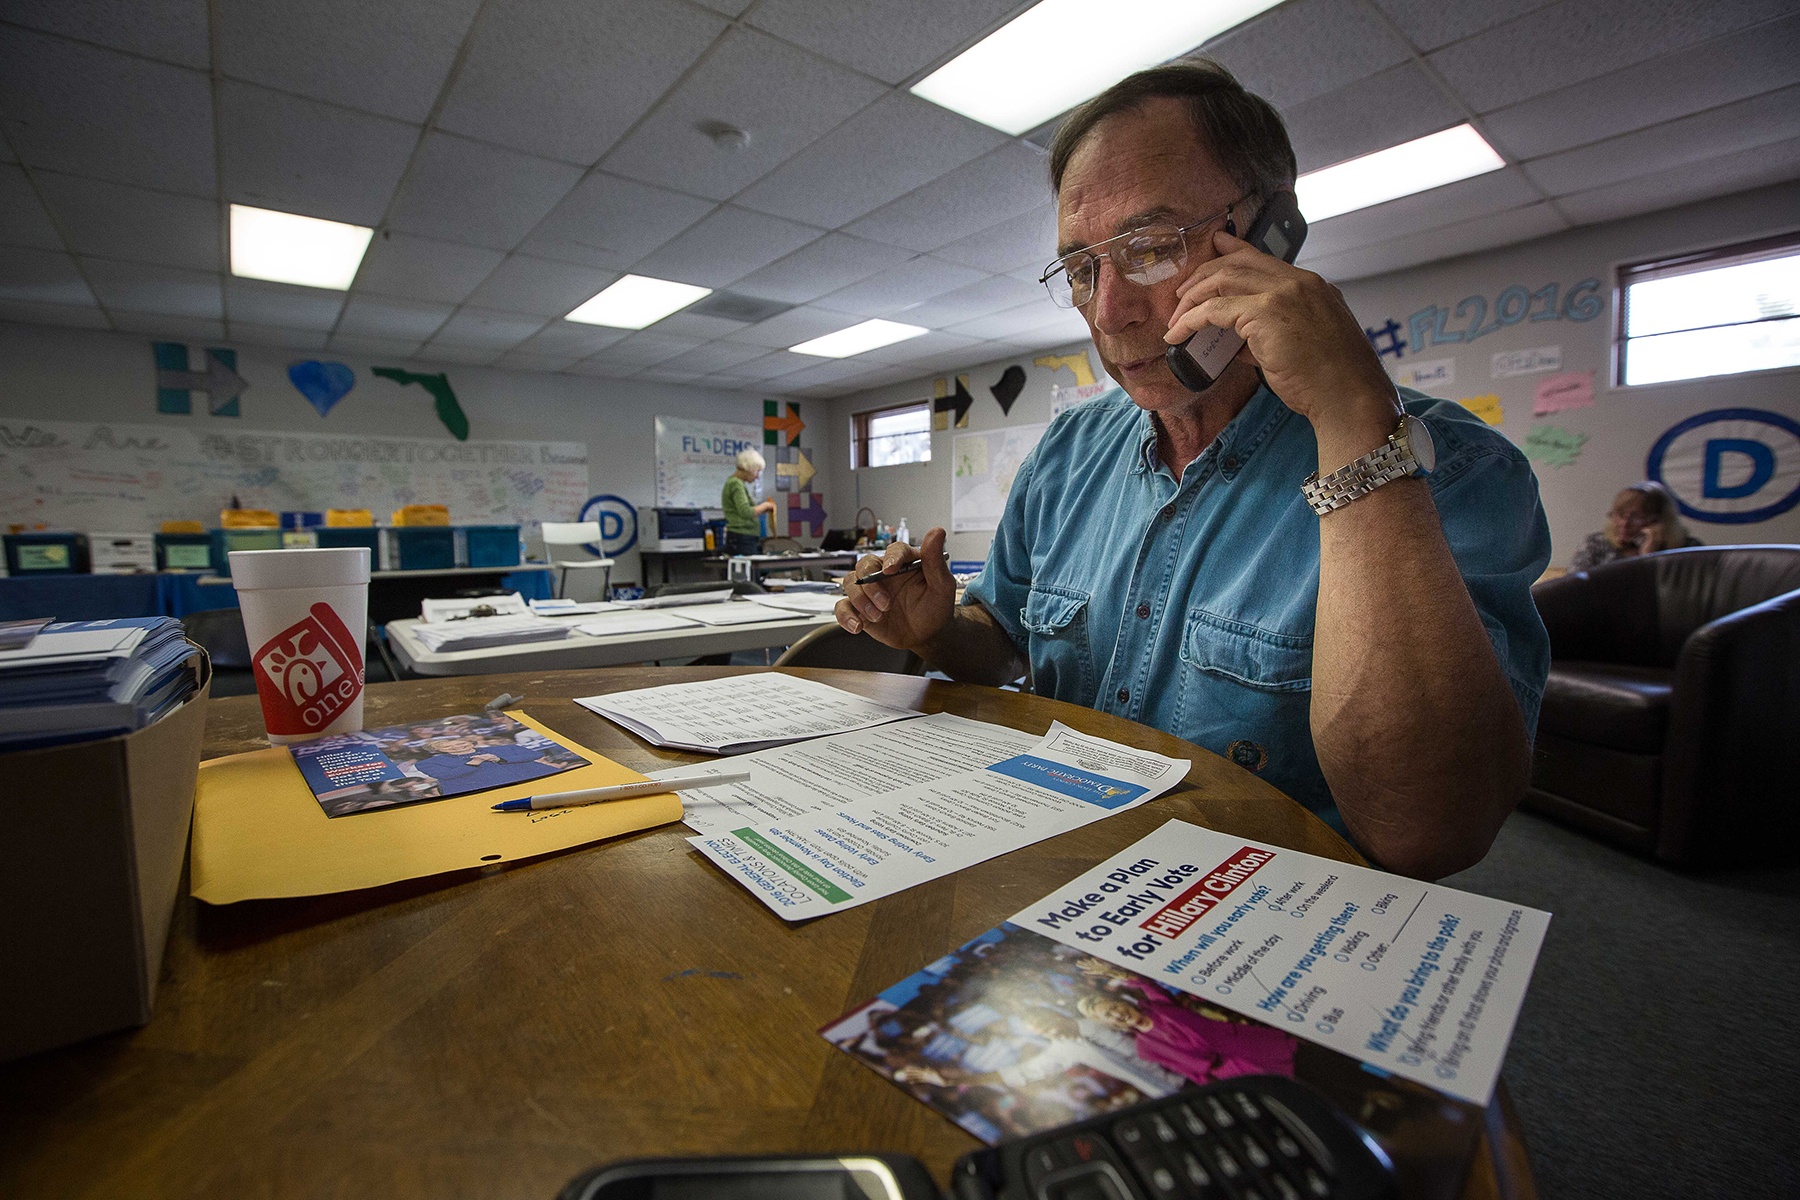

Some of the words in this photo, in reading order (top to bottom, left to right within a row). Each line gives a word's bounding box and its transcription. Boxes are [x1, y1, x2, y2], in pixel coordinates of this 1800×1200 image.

[1367, 278, 1606, 358] #FL2016
[682, 435, 701, 453] FL
[1702, 439, 1777, 499] D
[600, 510, 624, 541] D
[303, 679, 355, 727] one
[1021, 762, 1048, 771] PARTY
[1047, 769, 1115, 792] DEMOCRATIC
[870, 830, 890, 839] Sites
[704, 840, 741, 864] ELECTION
[717, 838, 746, 856] TIMES
[780, 835, 814, 856] November
[835, 841, 858, 854] Voting
[888, 838, 913, 853] Voting
[818, 859, 835, 868] Day
[858, 854, 879, 866] Early
[913, 852, 936, 863] Early
[738, 864, 775, 890] GENERAL
[833, 868, 866, 888] Election
[1107, 859, 1159, 884] Plan
[746, 862, 812, 904] LOCATIONS
[1100, 883, 1122, 893] a
[1316, 875, 1338, 896] weekend
[770, 892, 796, 906] 2016
[1076, 926, 1112, 942] to
[1099, 890, 1166, 926] Early
[1146, 865, 1199, 889] Vote
[1275, 892, 1292, 906] After
[1289, 882, 1305, 893] work
[1305, 896, 1319, 904] the
[1376, 894, 1398, 909] Biking
[1037, 894, 1105, 929] Make
[1117, 934, 1162, 960] for
[1147, 891, 1220, 936] Hillary
[1204, 853, 1272, 892] Clinton.
[1297, 901, 1314, 912] On
[1164, 950, 1202, 974] When
[1195, 934, 1217, 950] will
[1211, 922, 1233, 937] you
[1228, 904, 1255, 922] early
[1246, 886, 1272, 904] vote?
[1439, 914, 1460, 938] polls?
[1340, 931, 1370, 954] Walking
[1428, 937, 1449, 951] the
[1199, 956, 1228, 977] Before
[1225, 940, 1243, 956] work
[1224, 963, 1252, 986] Middle
[1253, 945, 1270, 957] the
[1264, 934, 1283, 946] day
[1257, 988, 1288, 1012] How
[1282, 972, 1302, 988] are
[1295, 954, 1317, 973] you
[1310, 926, 1345, 956] getting
[1330, 902, 1360, 926] there?
[1421, 952, 1440, 962] to
[1405, 961, 1440, 987] bring
[1400, 986, 1421, 1006] you
[1323, 1008, 1344, 1024] Bus
[1386, 1006, 1409, 1020] do
[1367, 1019, 1401, 1053] What
